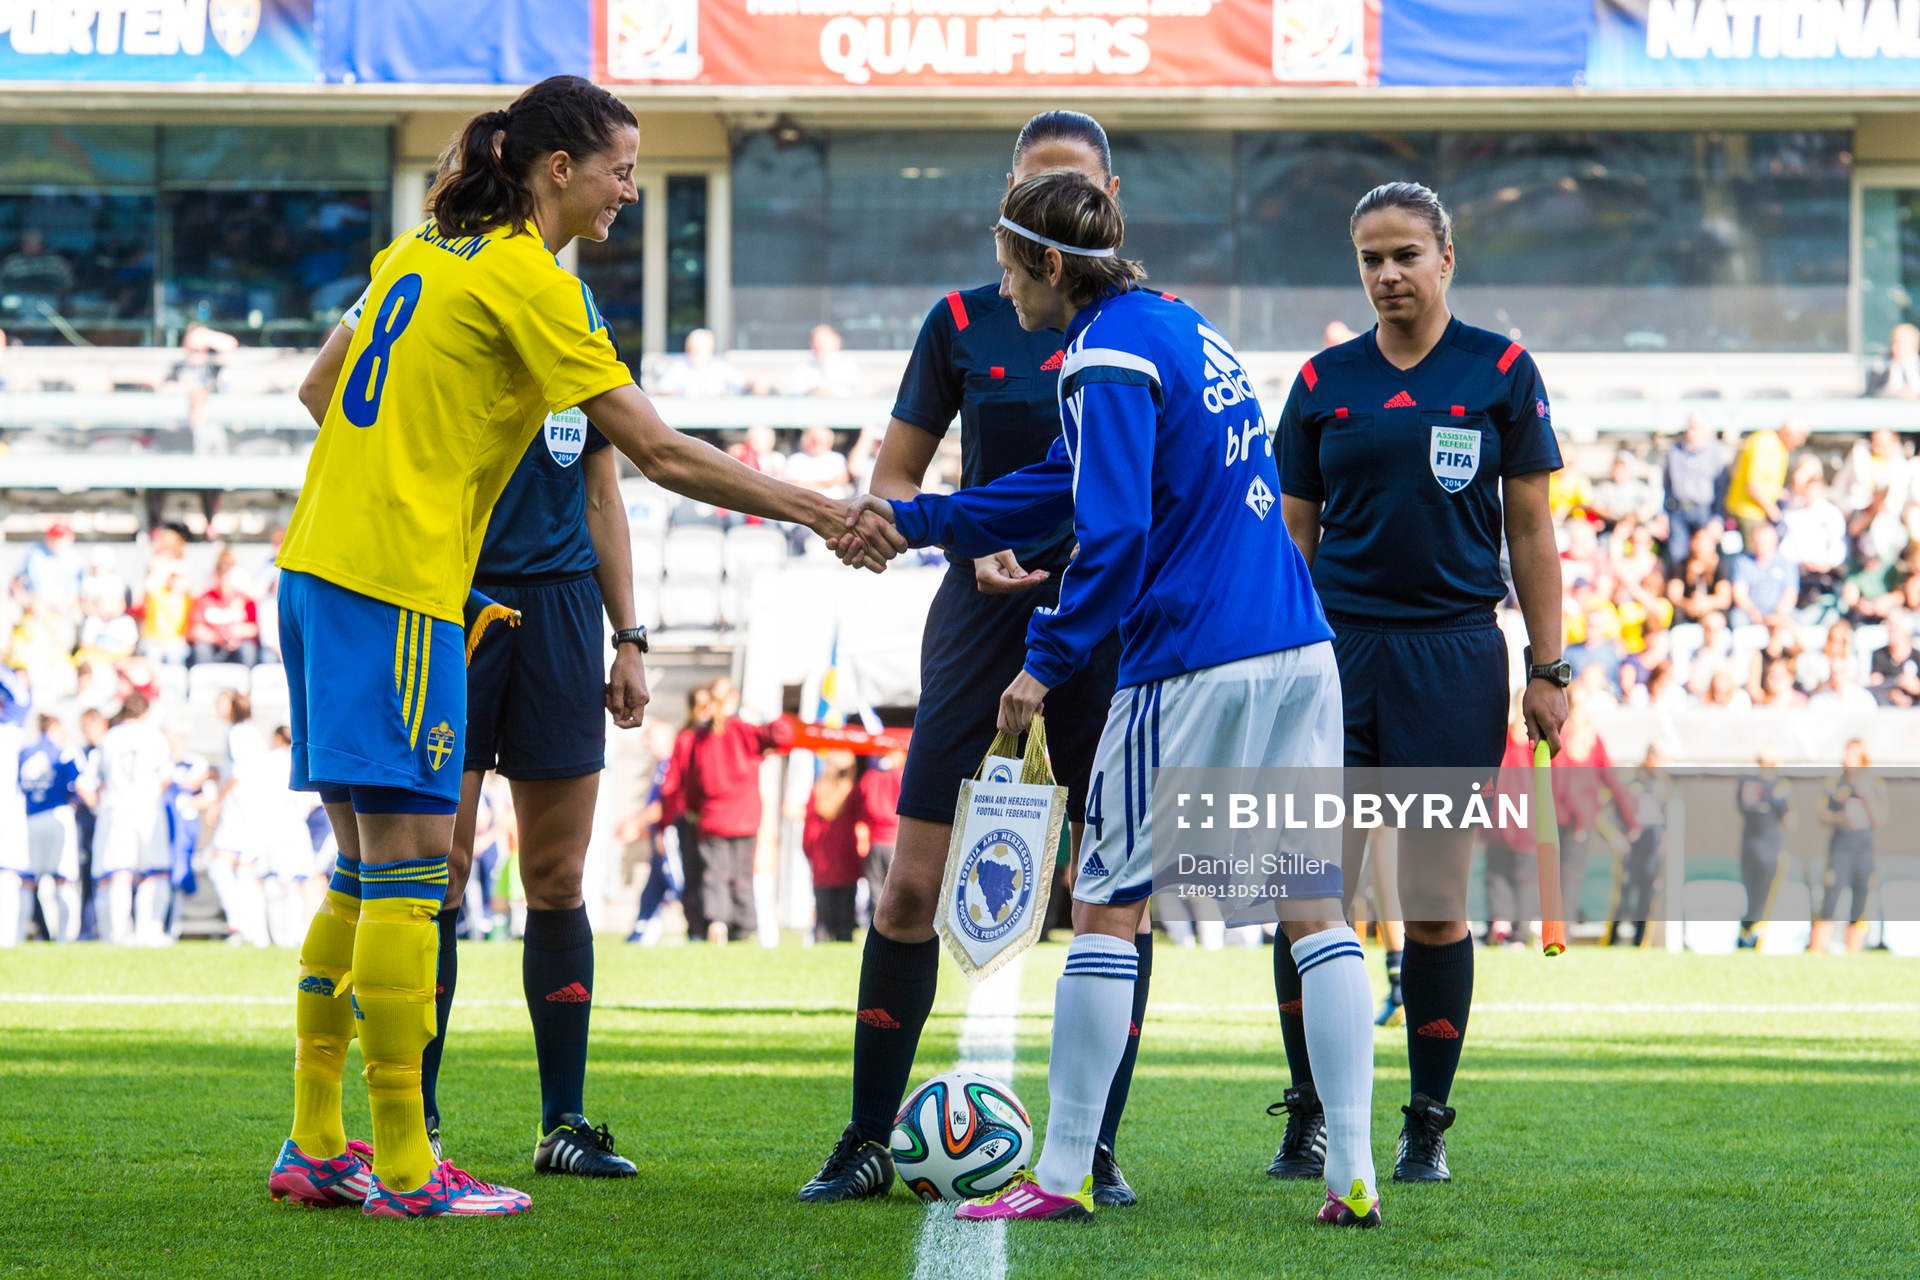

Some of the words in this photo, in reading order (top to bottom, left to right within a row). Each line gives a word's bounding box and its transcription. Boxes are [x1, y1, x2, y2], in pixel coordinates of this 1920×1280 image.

[0, 0, 206, 55] ORTEN
[819, 17, 1150, 84] QUALIFIERS
[342, 273, 422, 428] 8
[550, 426, 581, 442] FIFA
[1436, 431, 1478, 441] ASSISTANT
[1439, 440, 1473, 450] REFEREE
[558, 454, 573, 462] 2014
[1436, 451, 1473, 469] FIFA
[1444, 479, 1462, 488] 2014
[974, 794, 994, 804] BOSNIA
[995, 796, 1007, 805] AND
[1008, 796, 1048, 808] HERZEGOVINA
[1086, 770, 1104, 841] 4
[976, 807, 1003, 817] FOOTBALL
[1005, 809, 1042, 820] FEDERATION
[959, 847, 981, 887] BOSNIA
[983, 833, 999, 847] AND
[1001, 832, 1032, 892] HERZEGOVINA
[958, 900, 980, 937] FOOTBALL
[981, 905, 1024, 939] FEDERATION
